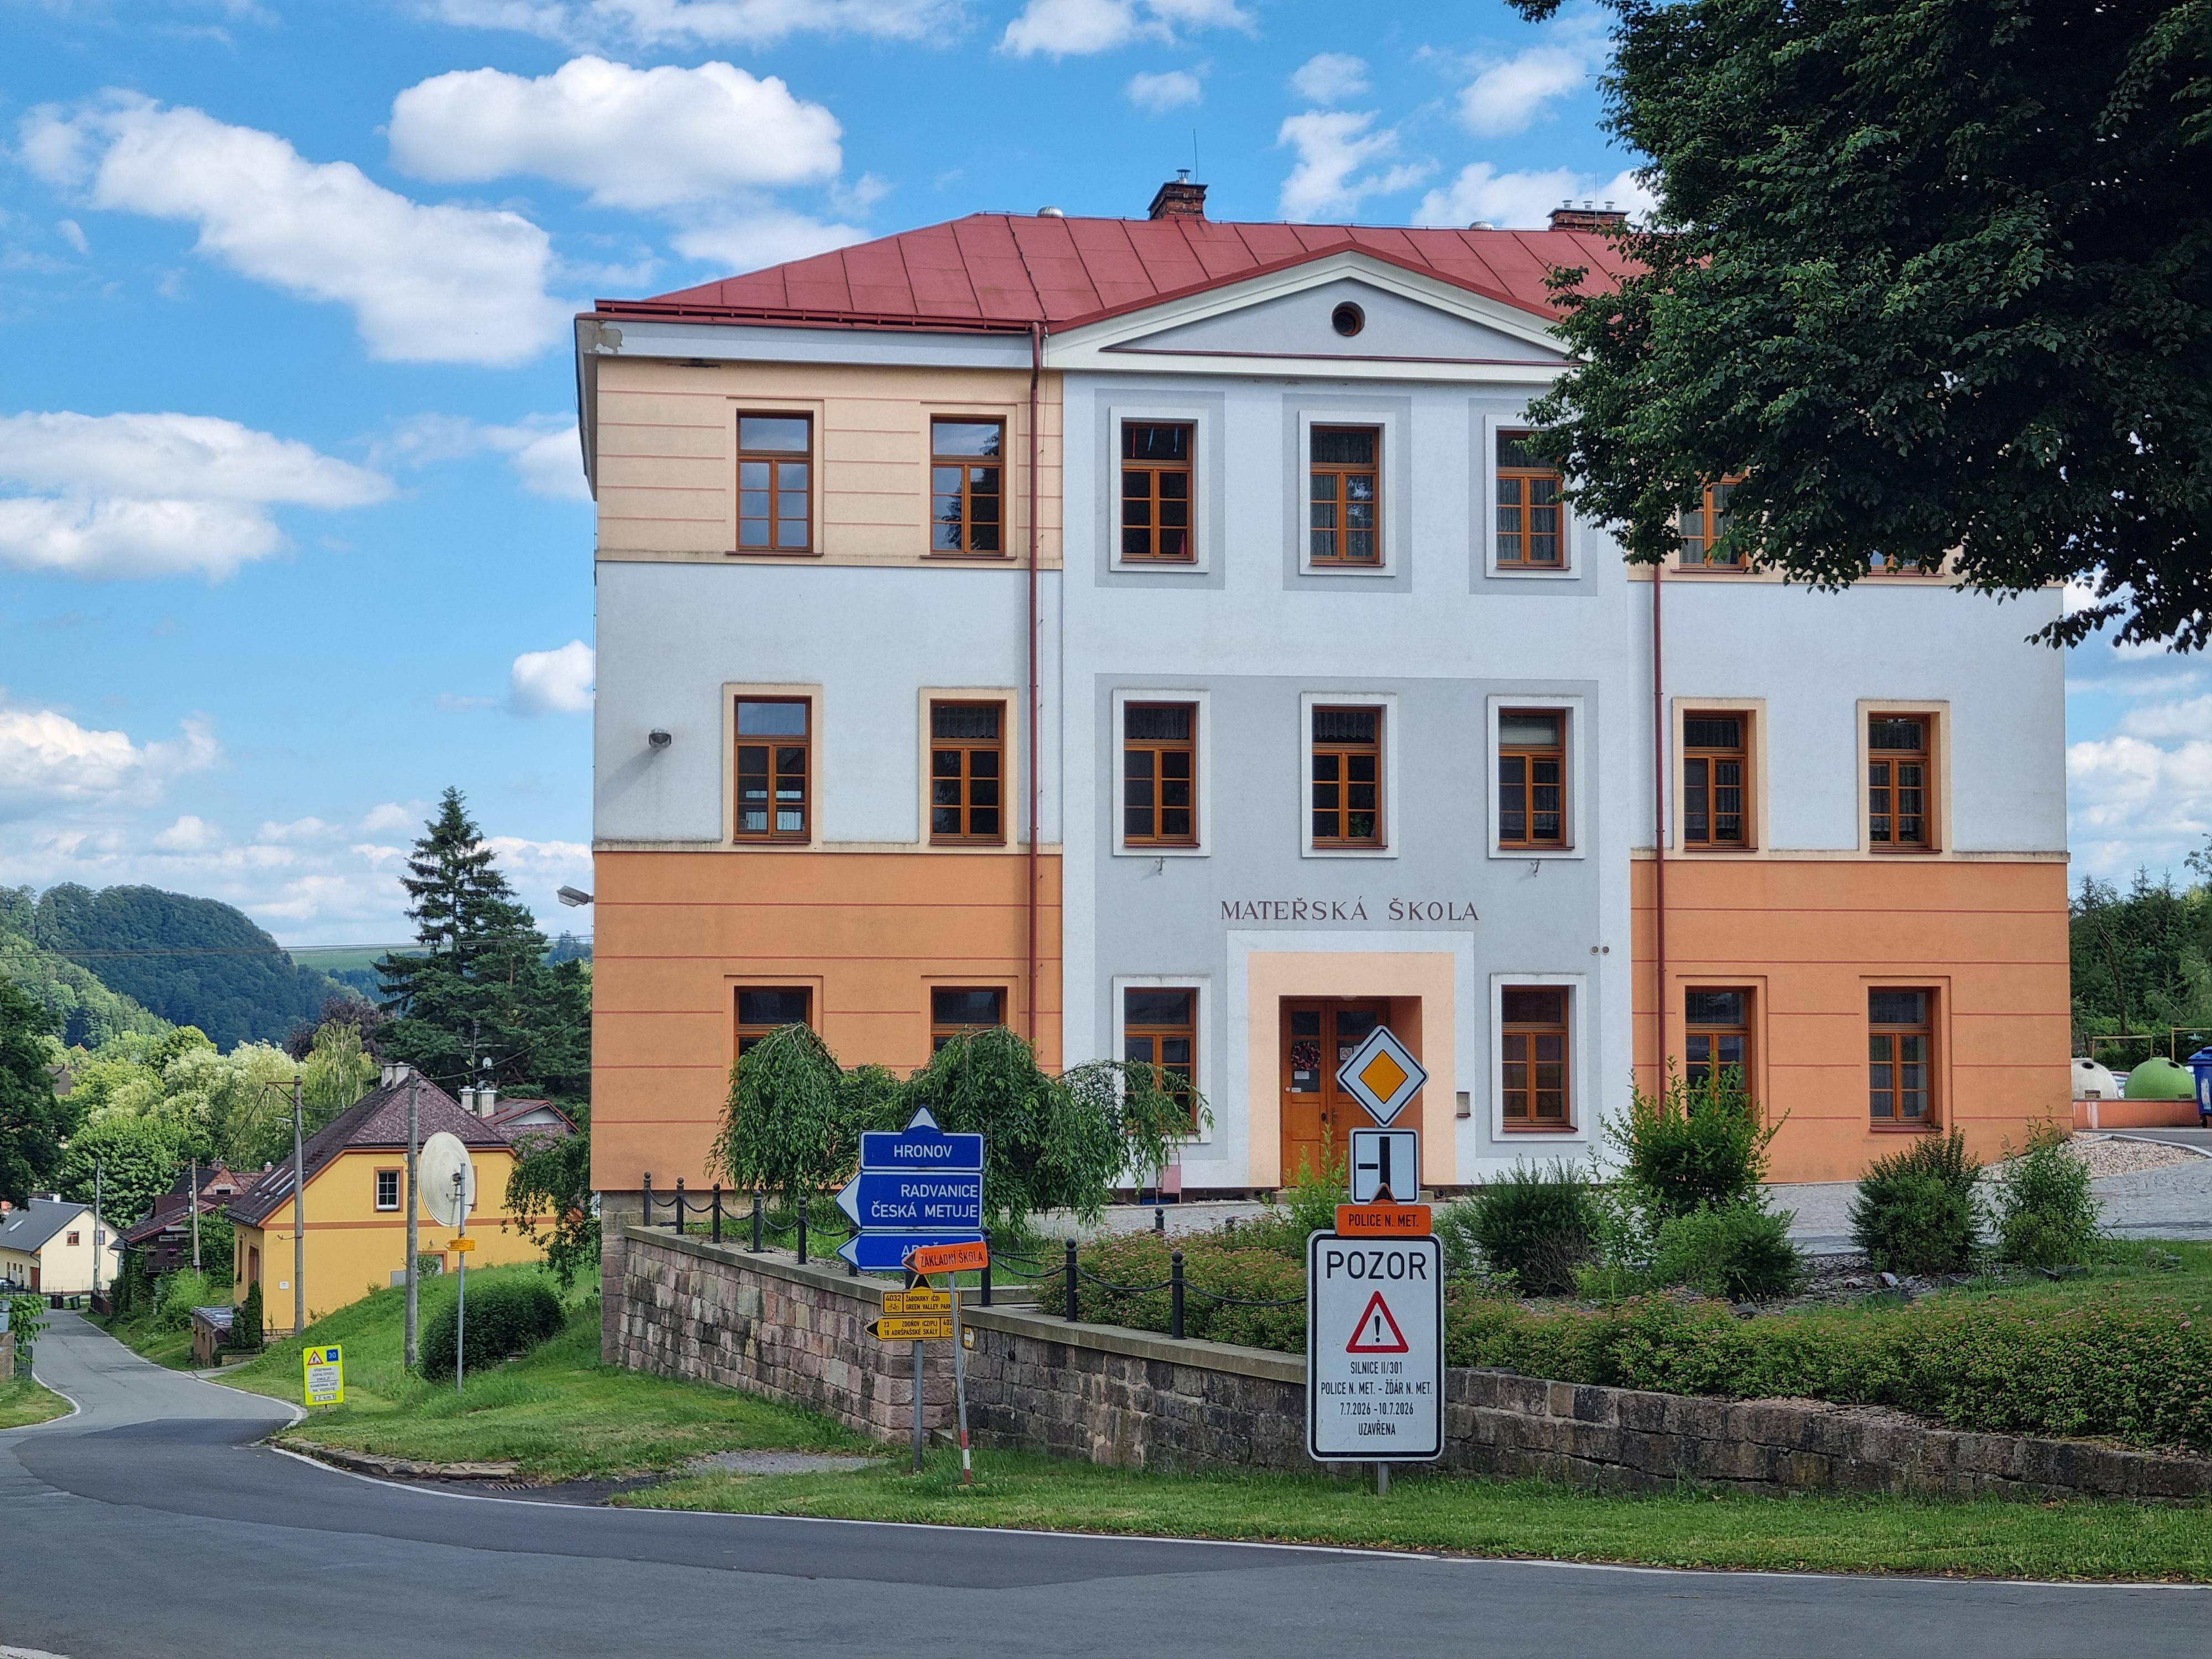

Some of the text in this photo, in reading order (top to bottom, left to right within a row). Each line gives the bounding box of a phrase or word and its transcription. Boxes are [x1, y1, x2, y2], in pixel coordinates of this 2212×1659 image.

[1221, 895, 1479, 920] MATEŘSKÁ ŠKOLA
[894, 1145, 952, 1158] HRONOV
[901, 1184, 978, 1197] RADVANICE
[871, 1201, 978, 1218] ČESKÁ METUJE
[1349, 1213, 1419, 1227] POLICE N. MET.
[920, 1250, 984, 1267] ZÁKLADNÍ ŠKOLA
[1327, 1251, 1427, 1280] POZOR
[902, 1319, 920, 1327] ZDOŇOV
[1350, 1361, 1402, 1374] SILNICE II/301
[1321, 1382, 1346, 1395] POLICE
[1349, 1382, 1356, 1395] N.
[1359, 1382, 1375, 1395] MET.
[1385, 1379, 1404, 1395] ŽĎÁR
[1406, 1382, 1413, 1394] N.
[1416, 1382, 1432, 1394] MET.
[1340, 1402, 1371, 1415] 7.7.2026
[1358, 1420, 1395, 1436] UZAVŘENA
